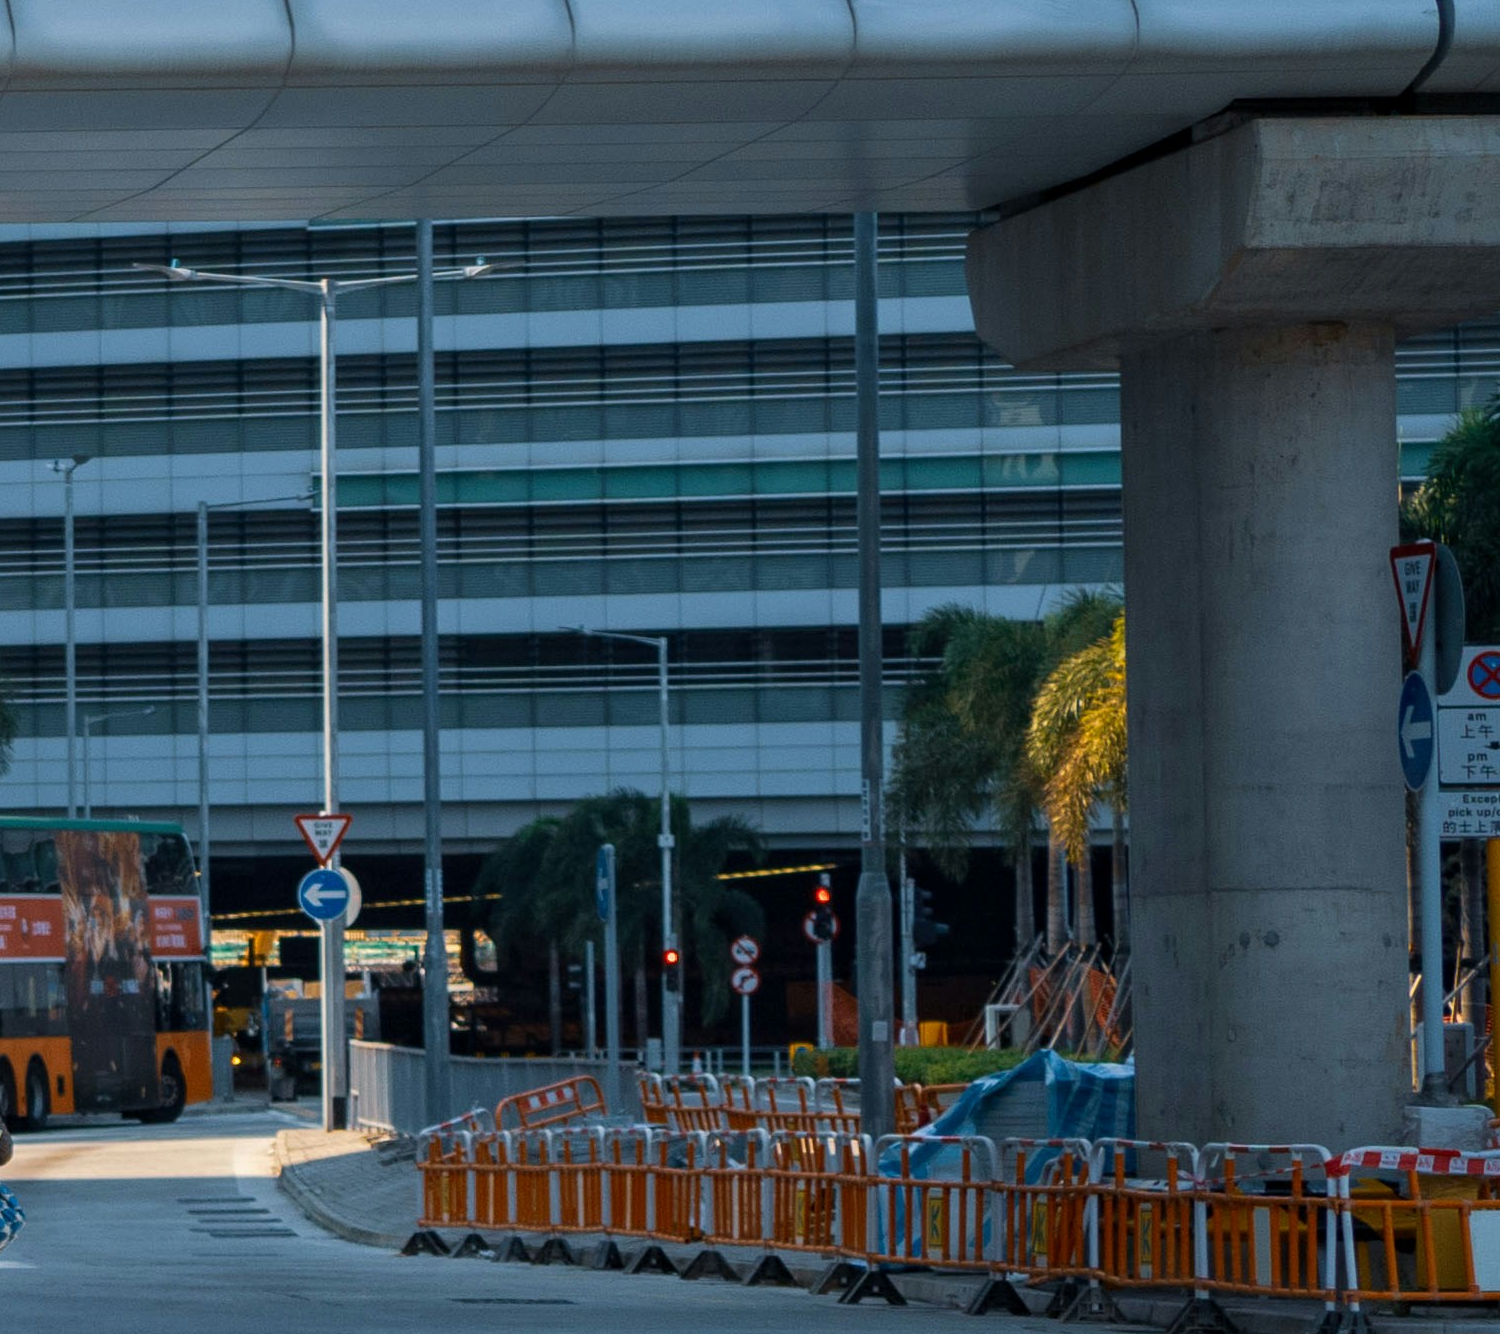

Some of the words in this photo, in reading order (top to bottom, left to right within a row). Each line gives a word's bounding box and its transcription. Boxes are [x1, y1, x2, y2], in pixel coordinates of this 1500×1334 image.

[1467, 712, 1487, 721] am
[1460, 724, 1494, 739] 上午
[1467, 753, 1488, 762] pm
[1448, 808, 1472, 818] pick
